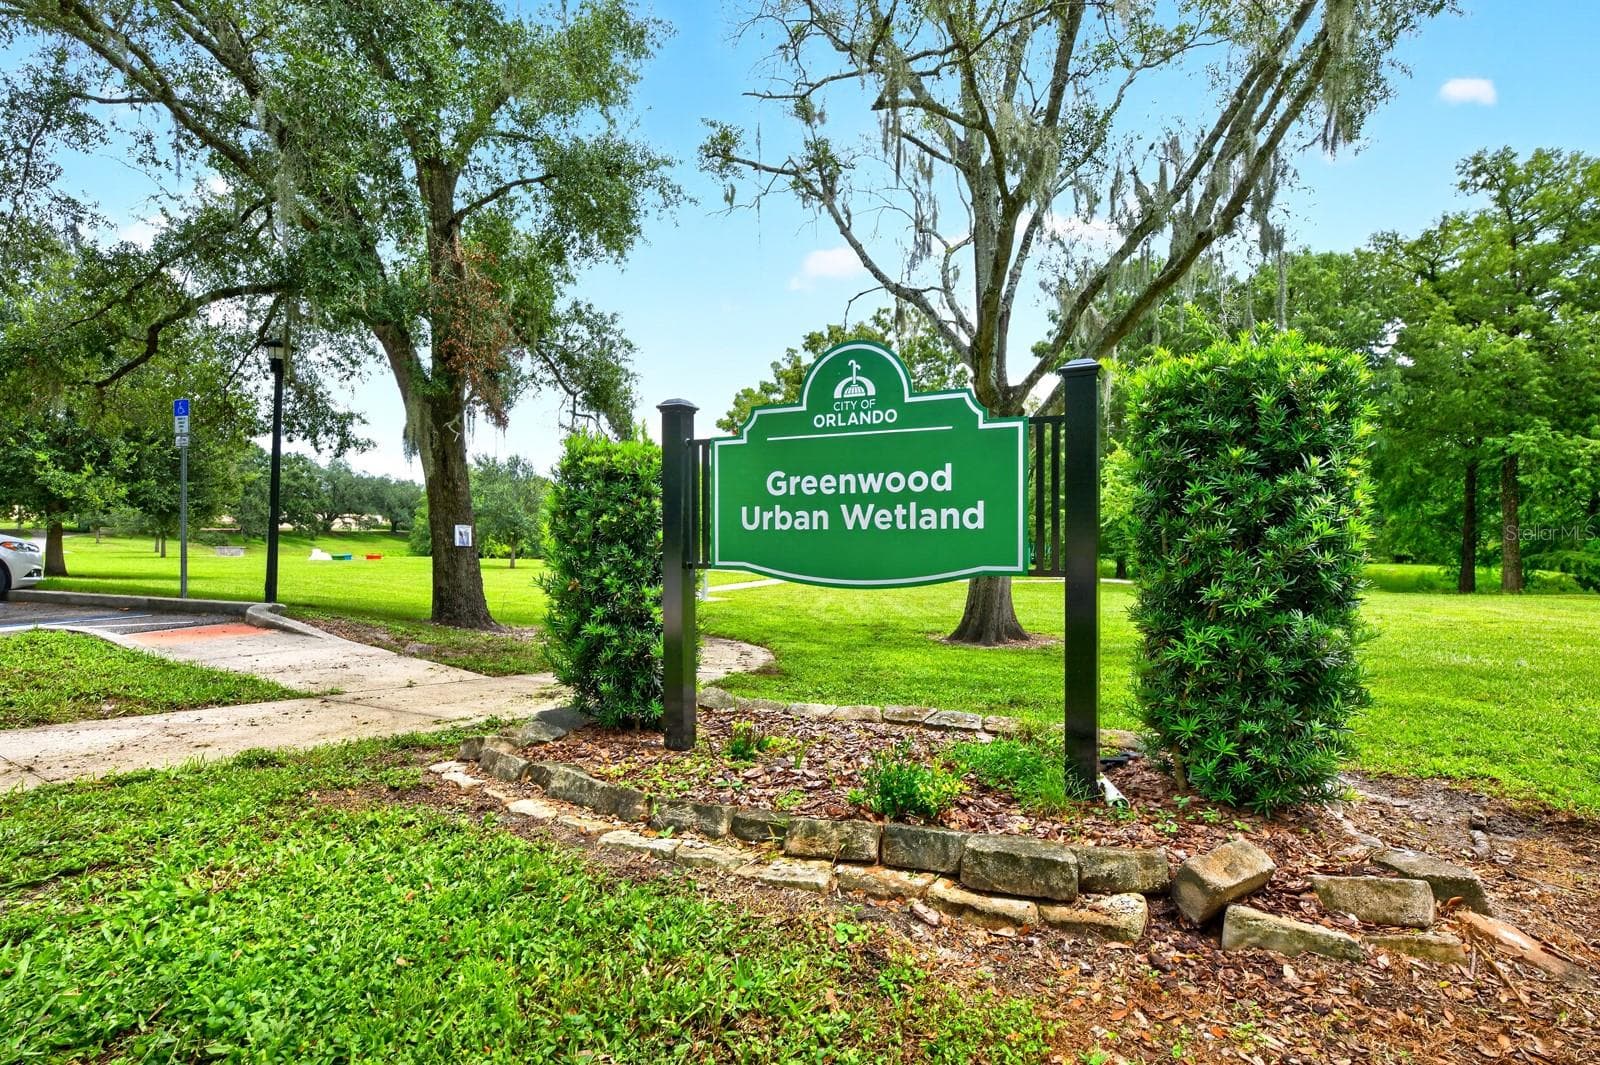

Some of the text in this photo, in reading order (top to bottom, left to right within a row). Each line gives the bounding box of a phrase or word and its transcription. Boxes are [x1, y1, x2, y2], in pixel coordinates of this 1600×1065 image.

[833, 398, 877, 411] CITY OF
[813, 409, 898, 429] ORLANDO
[766, 463, 953, 495] Greenwood
[741, 500, 985, 531] Urban Wetland
